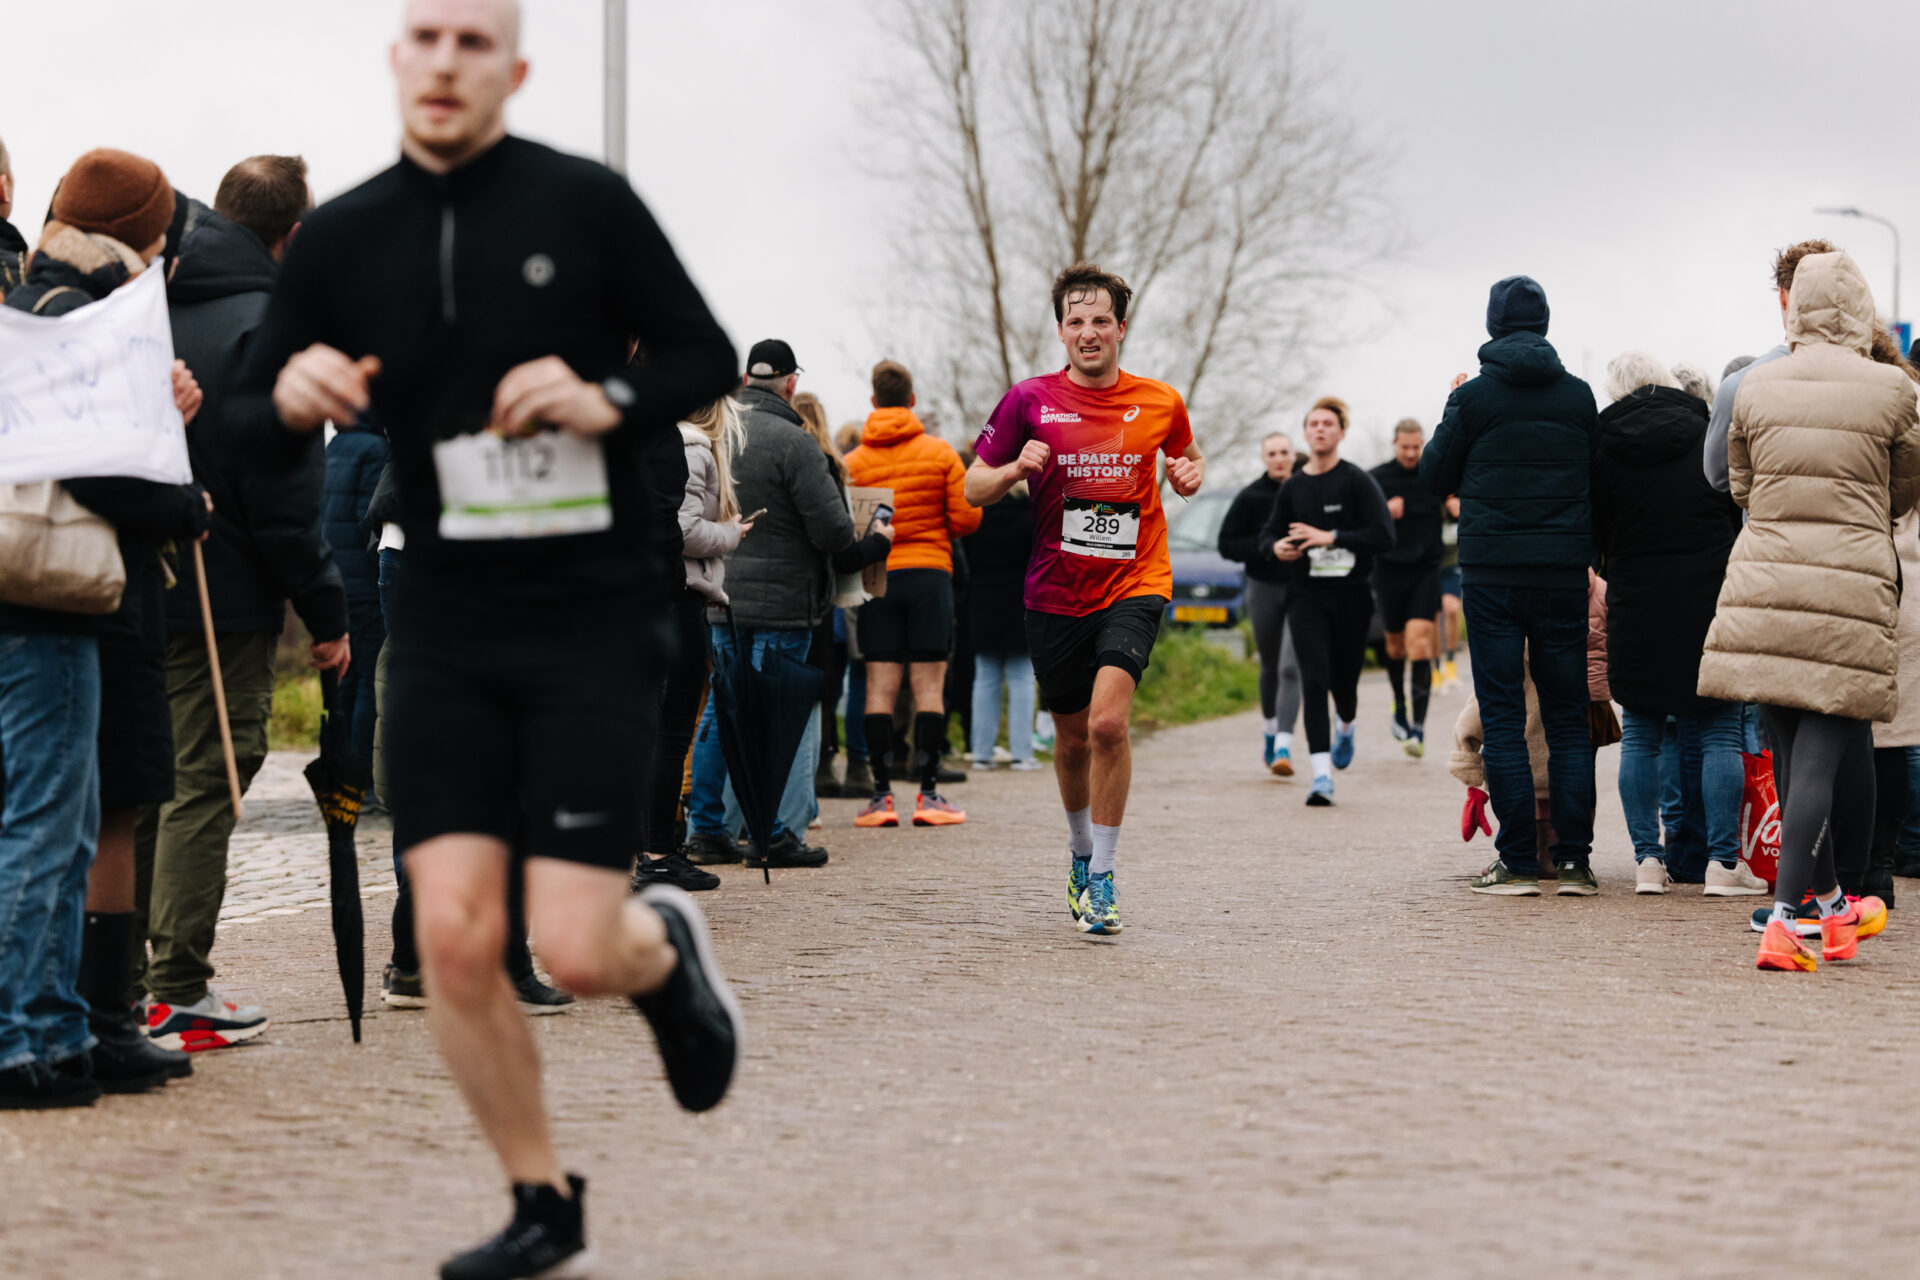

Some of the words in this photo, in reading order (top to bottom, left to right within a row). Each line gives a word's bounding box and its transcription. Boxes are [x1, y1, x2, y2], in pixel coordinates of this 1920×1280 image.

[1057, 454, 1077, 465] BE
[1079, 454, 1120, 465] PART
[1122, 454, 1142, 465] OF
[1067, 466, 1132, 478] HISTORY
[1083, 516, 1120, 535] 289
[1089, 534, 1112, 542] Willem
